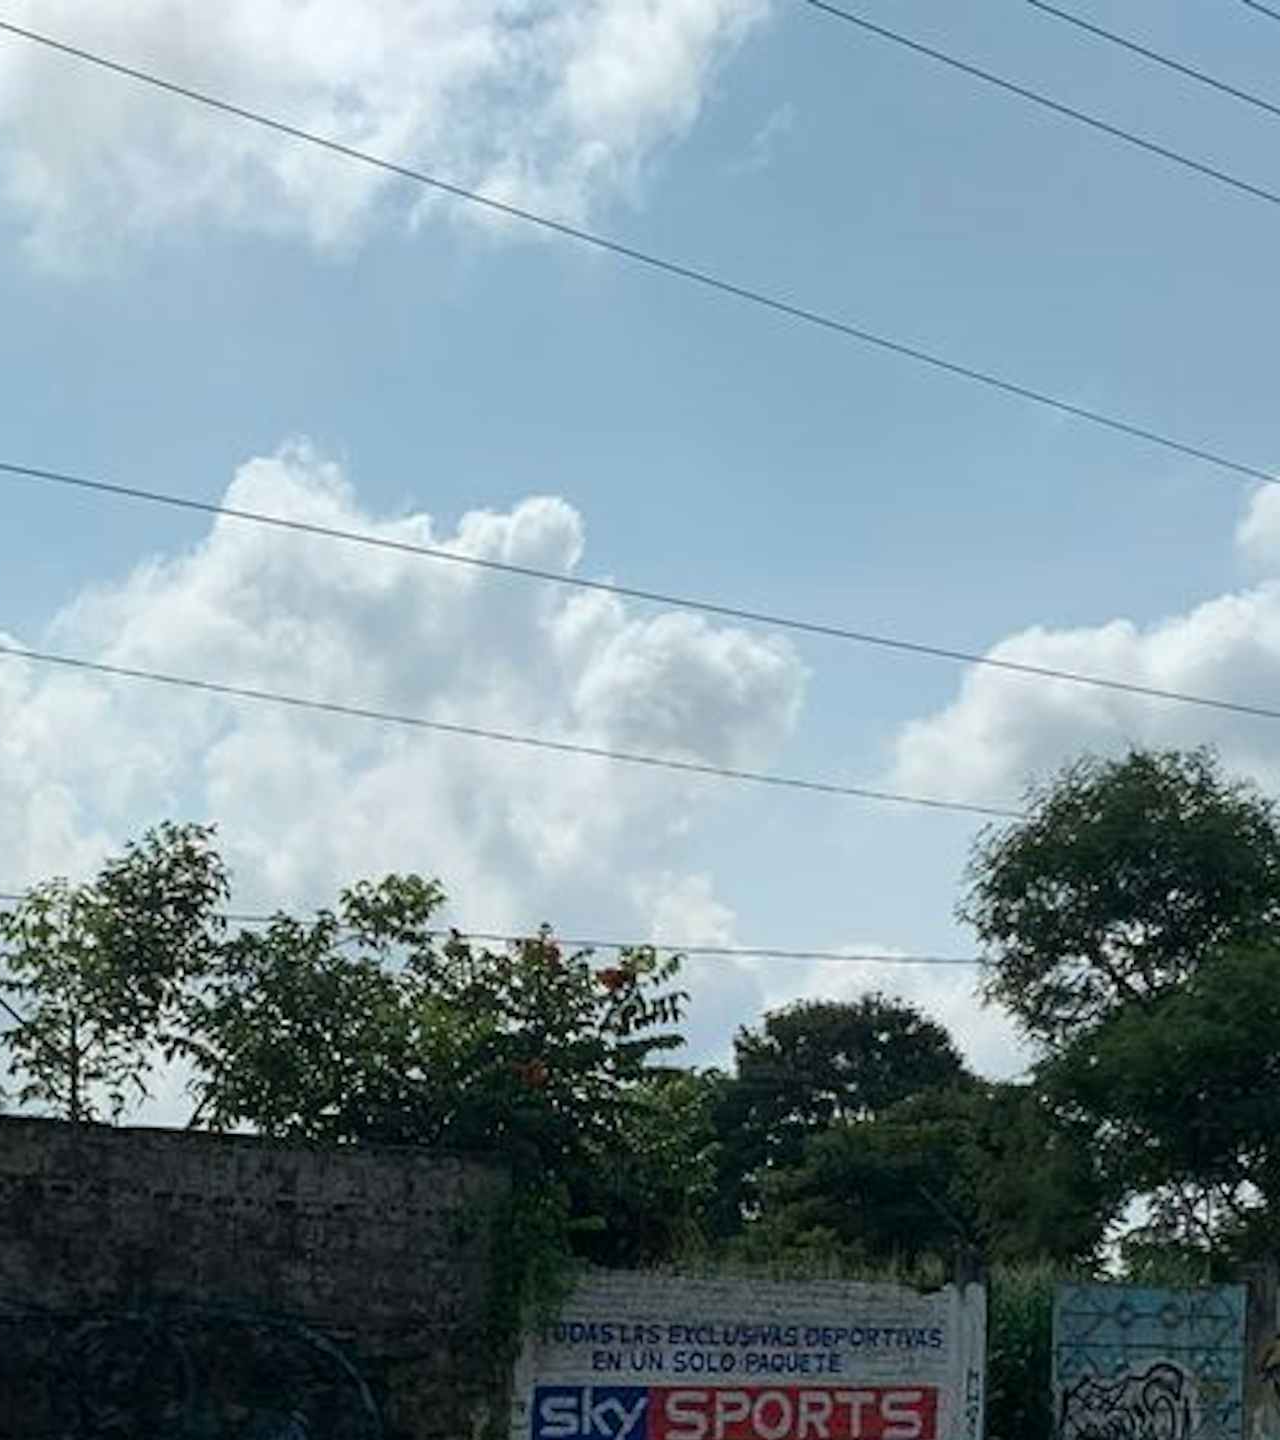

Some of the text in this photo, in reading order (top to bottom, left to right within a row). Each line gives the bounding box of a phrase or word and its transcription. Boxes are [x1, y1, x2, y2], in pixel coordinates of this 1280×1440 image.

[619, 1323, 662, 1345] LAS
[668, 1323, 799, 1347] EXCLUSIVAS
[804, 1327, 945, 1349] DEPORTIVAS
[591, 1350, 844, 1374] EN UN SOLO PAQUETE
